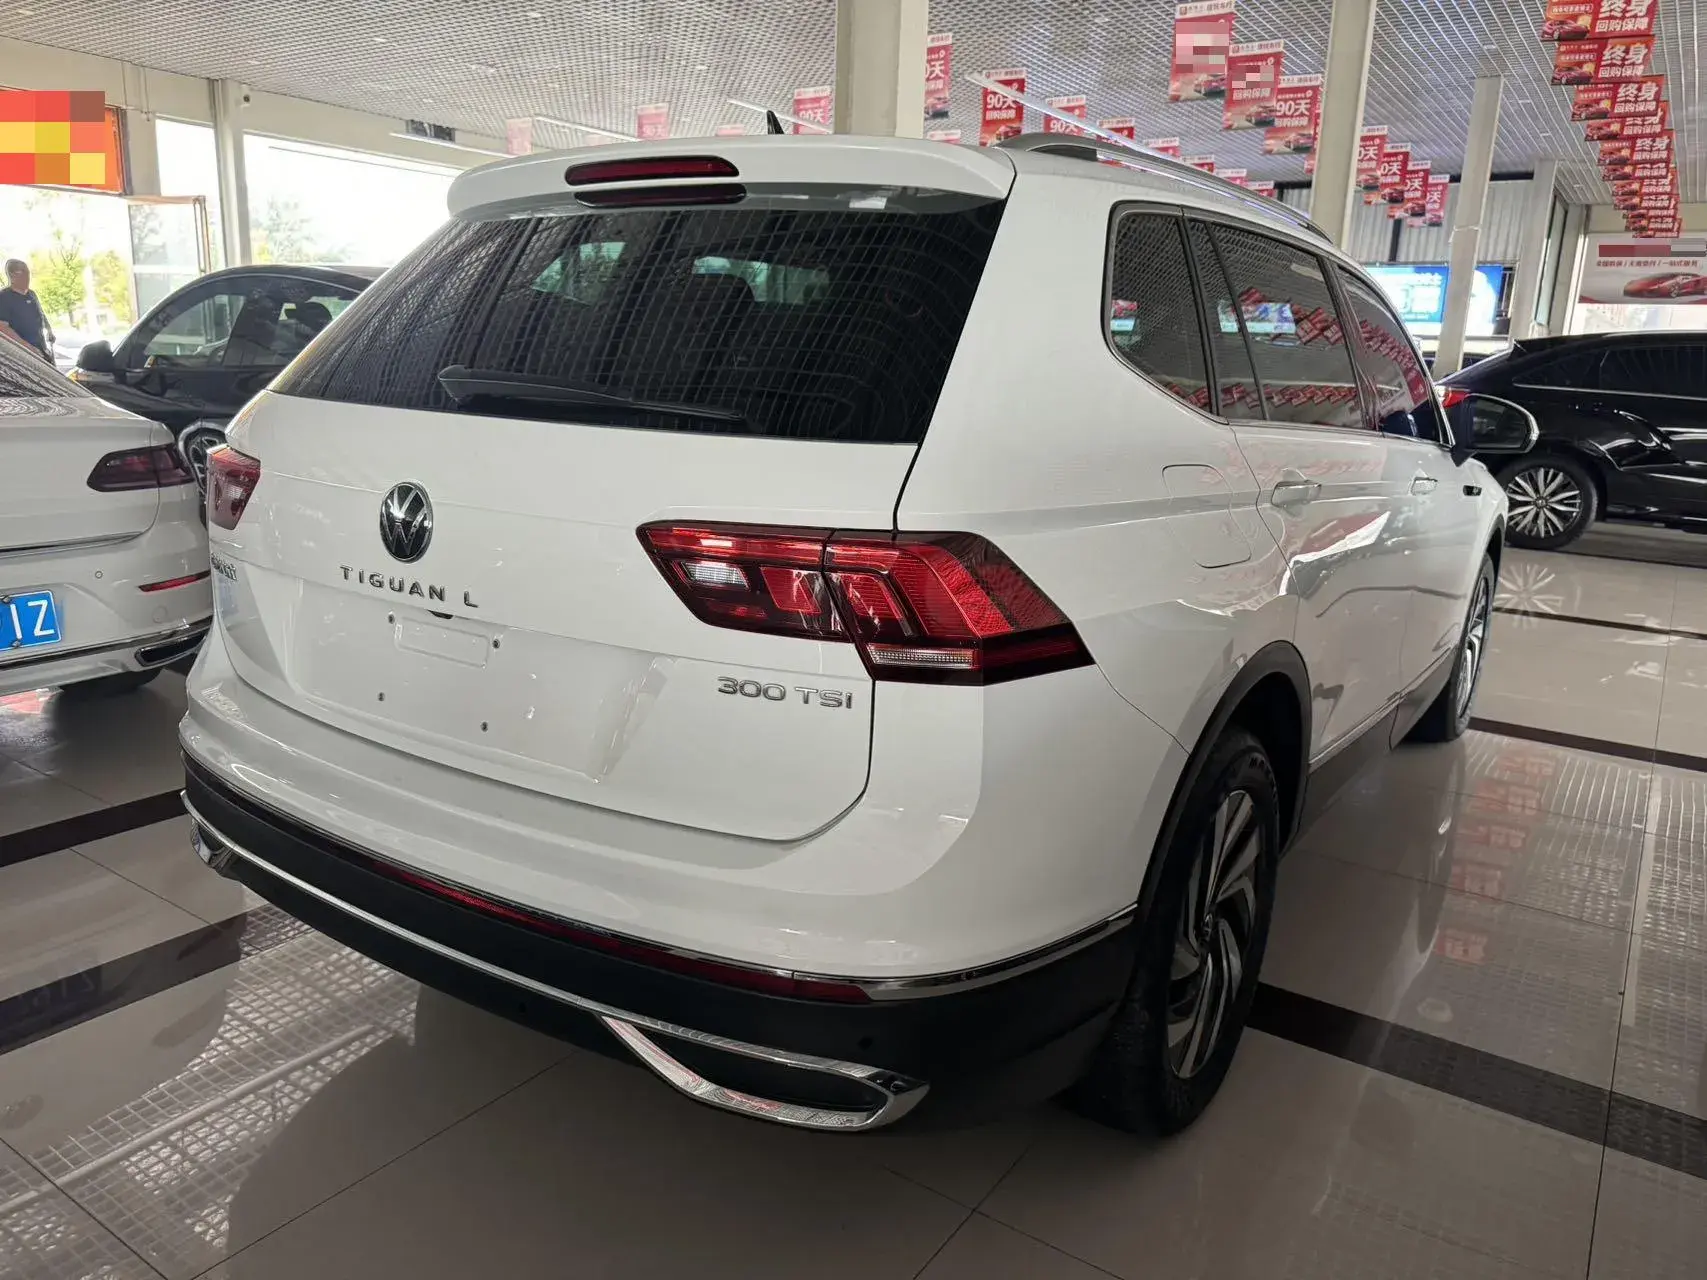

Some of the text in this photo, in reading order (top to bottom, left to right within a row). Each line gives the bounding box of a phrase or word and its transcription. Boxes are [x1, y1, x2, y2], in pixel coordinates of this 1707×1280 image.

[1595, 17, 1649, 32] 回购保障
[1601, 42, 1649, 65] 终身
[1598, 65, 1645, 78] 回购保障
[1616, 81, 1659, 102] 终身
[1276, 100, 1311, 116] 90天
[340, 564, 479, 608] TIGUAN L
[717, 676, 853, 709] 300 TSI
